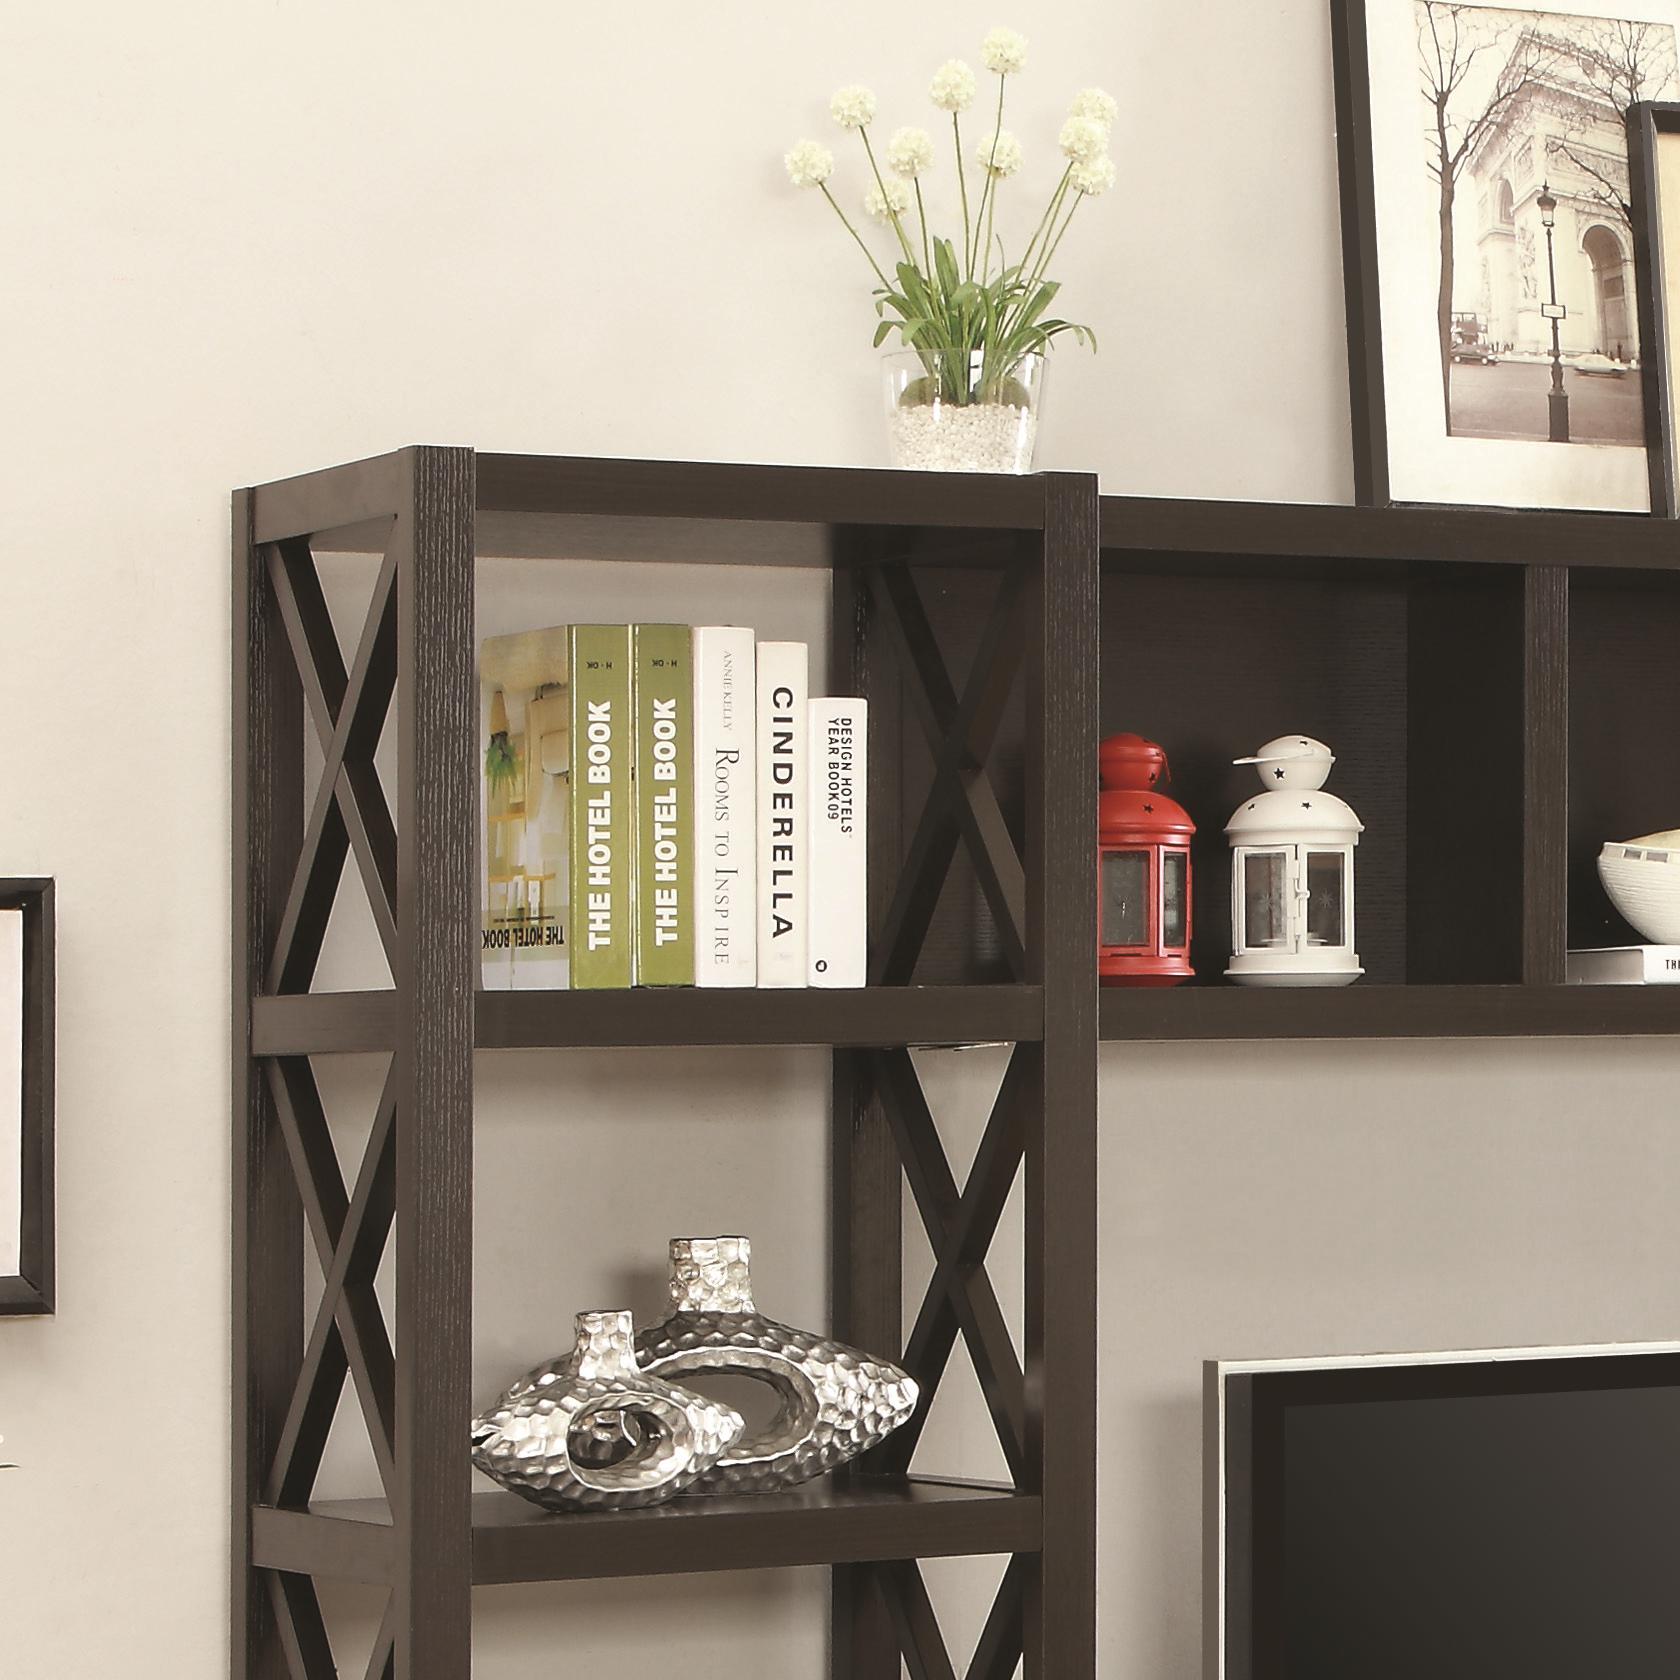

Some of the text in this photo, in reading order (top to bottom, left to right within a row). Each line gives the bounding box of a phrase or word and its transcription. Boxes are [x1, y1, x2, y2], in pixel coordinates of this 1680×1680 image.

[828, 718, 840, 755] YEAR
[841, 718, 852, 833] DESIGN HOTELS
[588, 701, 611, 951] THE HOTEL BOOK
[653, 698, 678, 946] THE HOTEL BOOK
[715, 832, 730, 857] TO
[773, 687, 793, 939] CINDERELLA
[481, 926, 565, 949] THE HOTEL BOOK
